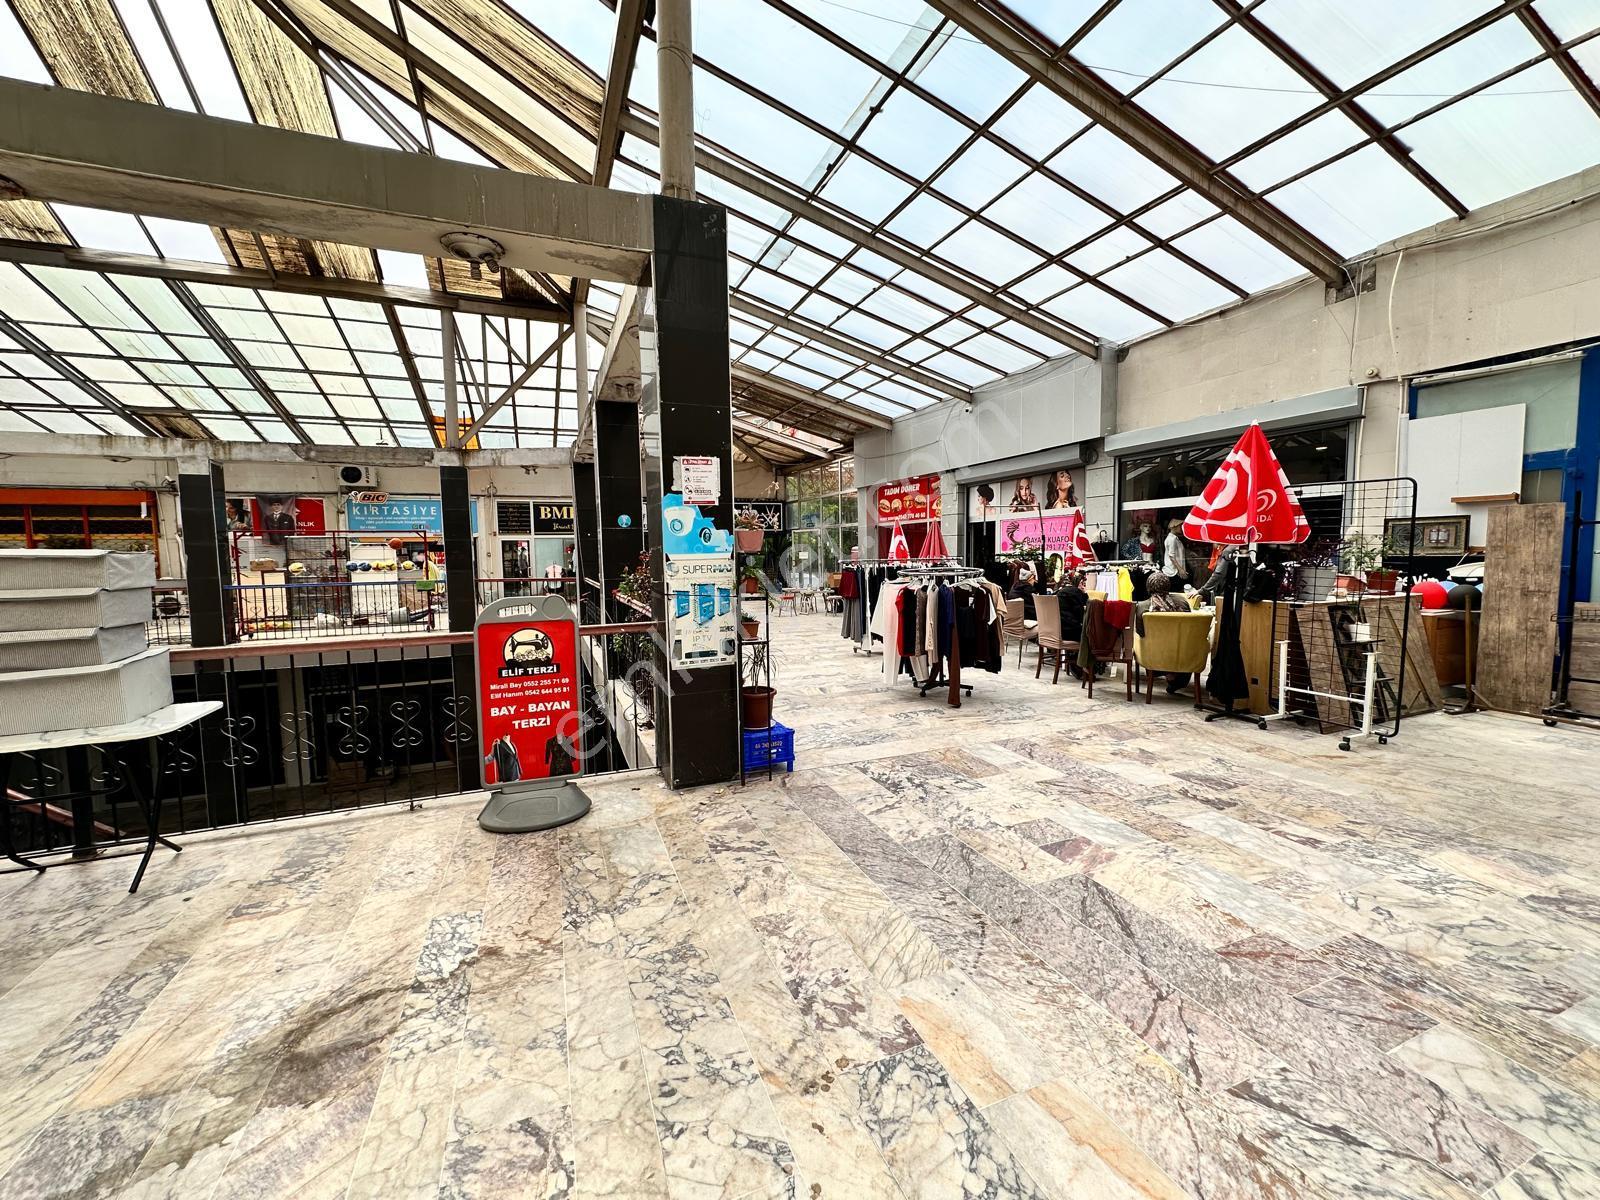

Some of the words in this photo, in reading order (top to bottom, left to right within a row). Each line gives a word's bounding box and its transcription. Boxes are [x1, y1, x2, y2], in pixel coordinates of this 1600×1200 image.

[352, 504, 437, 515] KIRTASİYE
[1027, 536, 1044, 544] BAYA
[502, 667, 524, 677] ELİF
[527, 665, 557, 675] TERZİ
[509, 682, 522, 690] Bay
[490, 705, 517, 717] BAY
[528, 701, 570, 713] BAYAN
[512, 715, 551, 729] TERZİ
